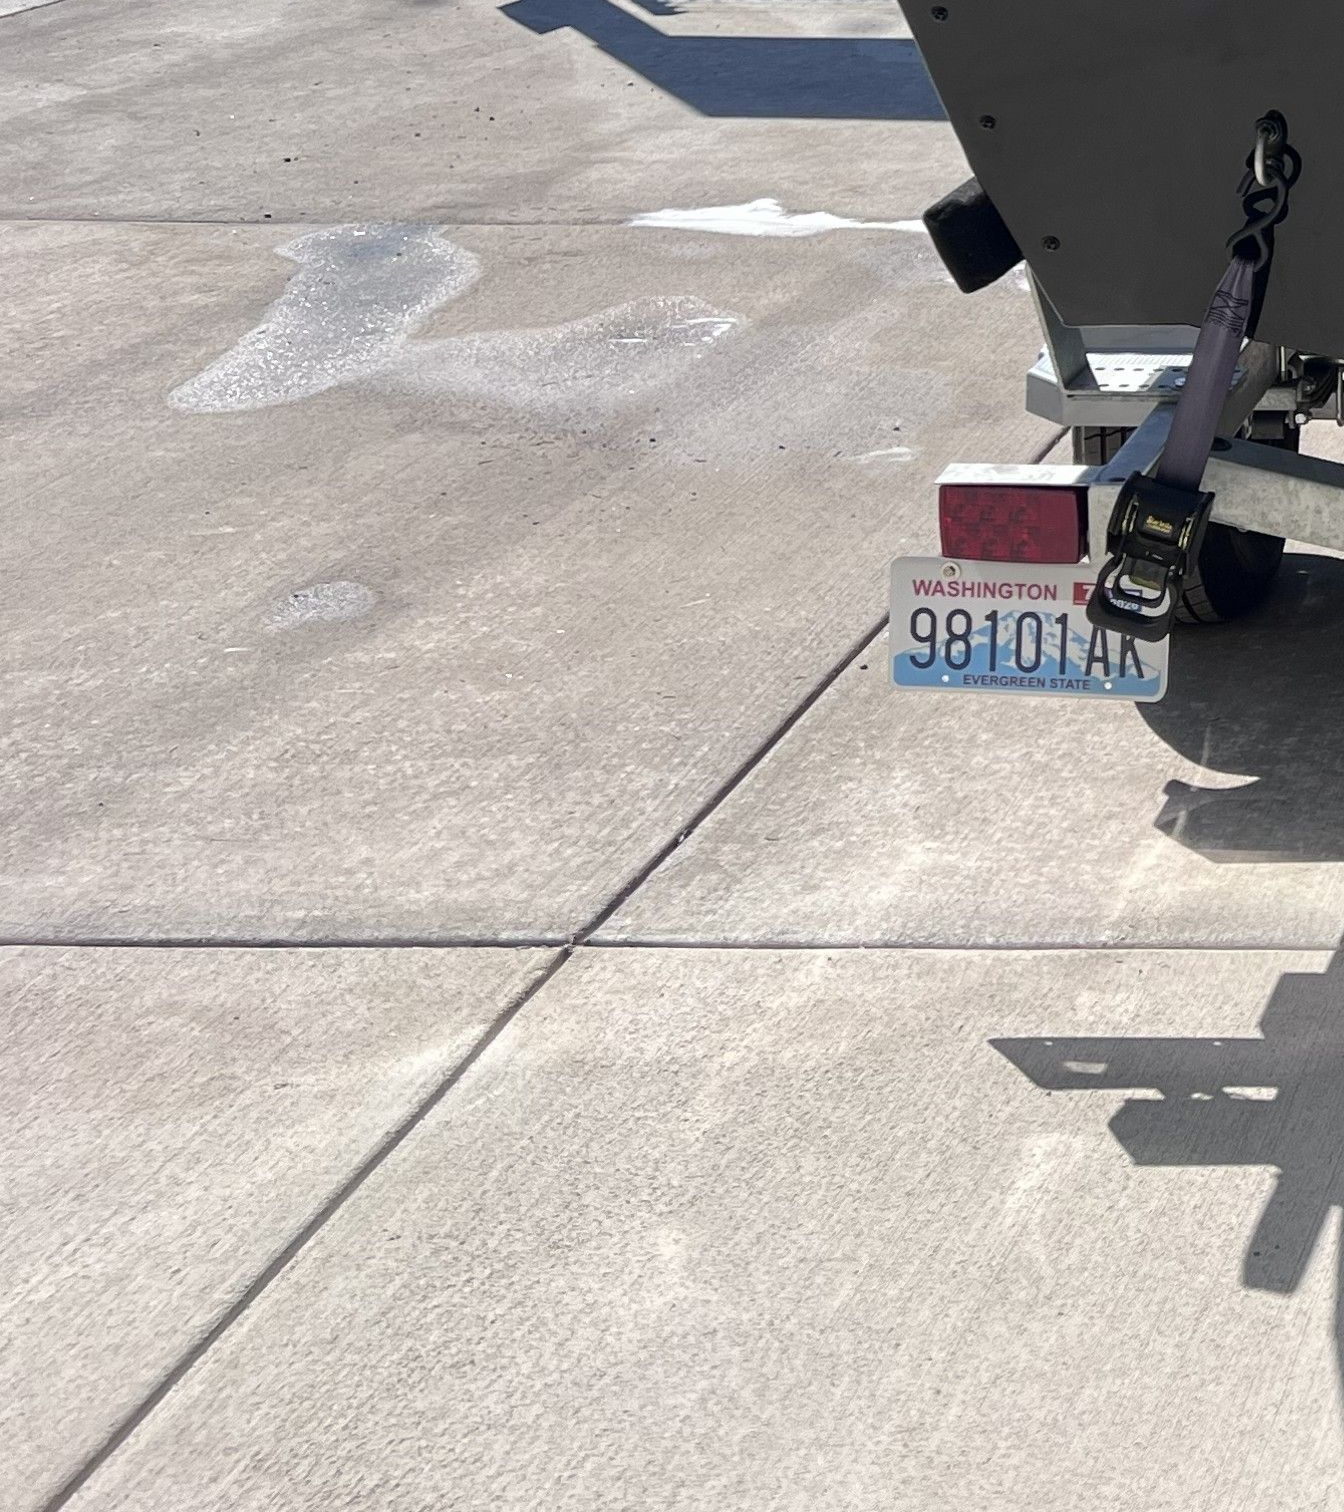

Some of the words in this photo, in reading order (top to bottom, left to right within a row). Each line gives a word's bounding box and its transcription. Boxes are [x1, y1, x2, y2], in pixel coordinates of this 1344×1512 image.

[912, 579, 1058, 601] WASHINGTON
[909, 607, 1145, 679] 98101AK
[963, 674, 1045, 688] EVERGREEN
[1050, 678, 1091, 690] STATE
